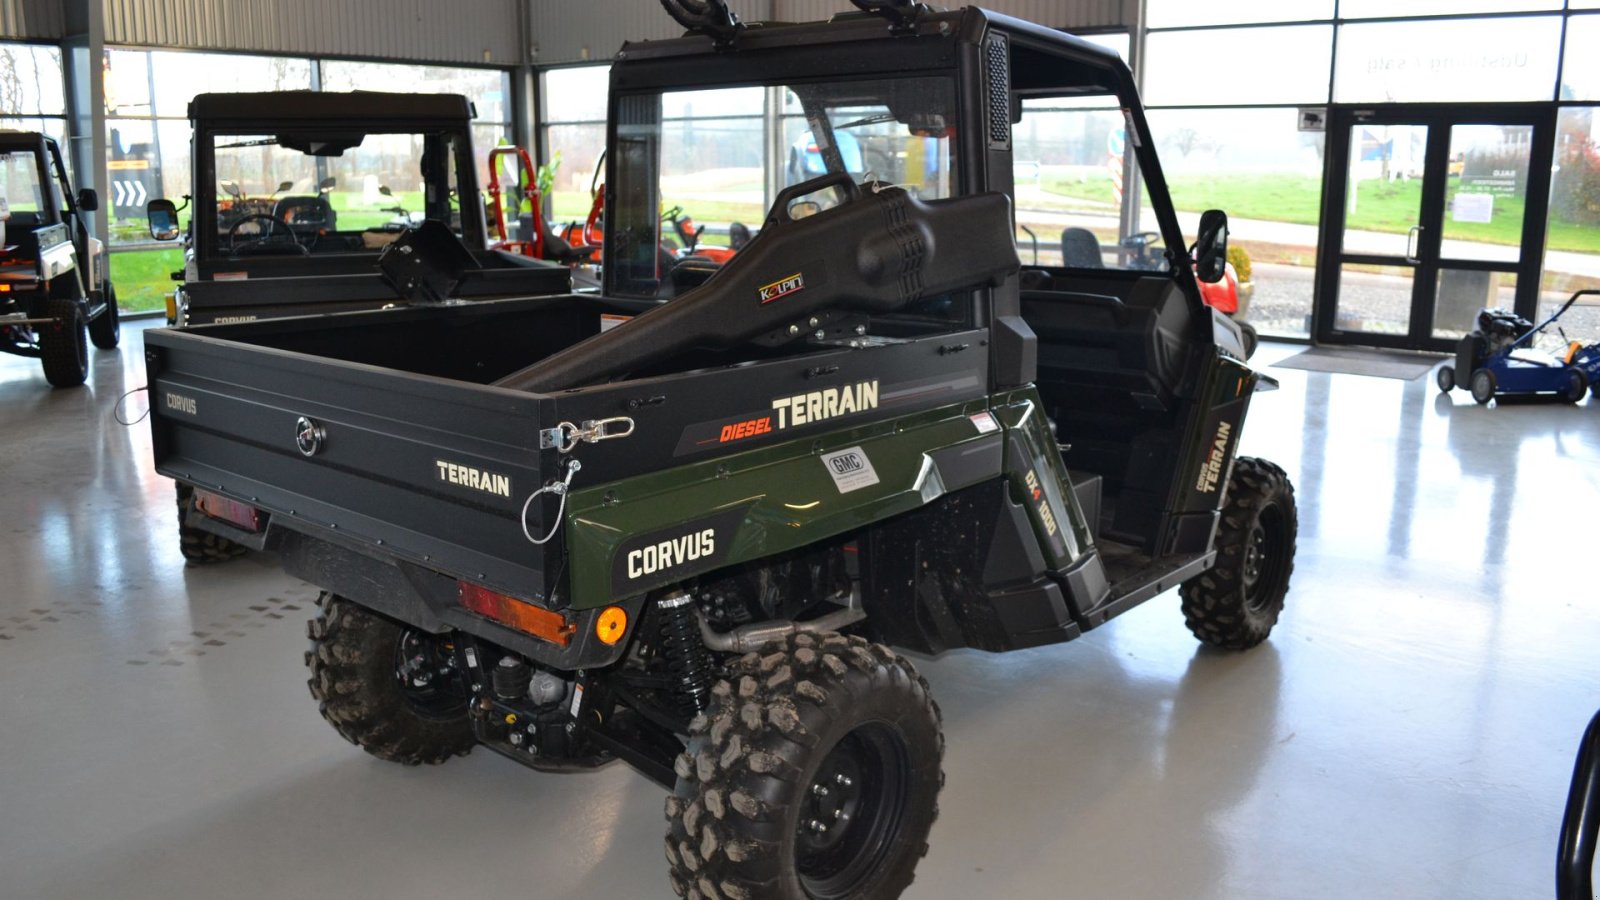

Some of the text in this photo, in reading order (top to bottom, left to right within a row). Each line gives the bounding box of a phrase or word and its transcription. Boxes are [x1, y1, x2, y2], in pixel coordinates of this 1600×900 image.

[166, 392, 197, 415] CORVUS
[719, 380, 879, 443] DIESEL TERRAIN
[832, 454, 861, 472] GMC
[1203, 420, 1232, 493] TERRAIN
[436, 460, 510, 497] TERRAIN
[1039, 499, 1057, 537] 1000
[627, 528, 715, 579] CORVUS
